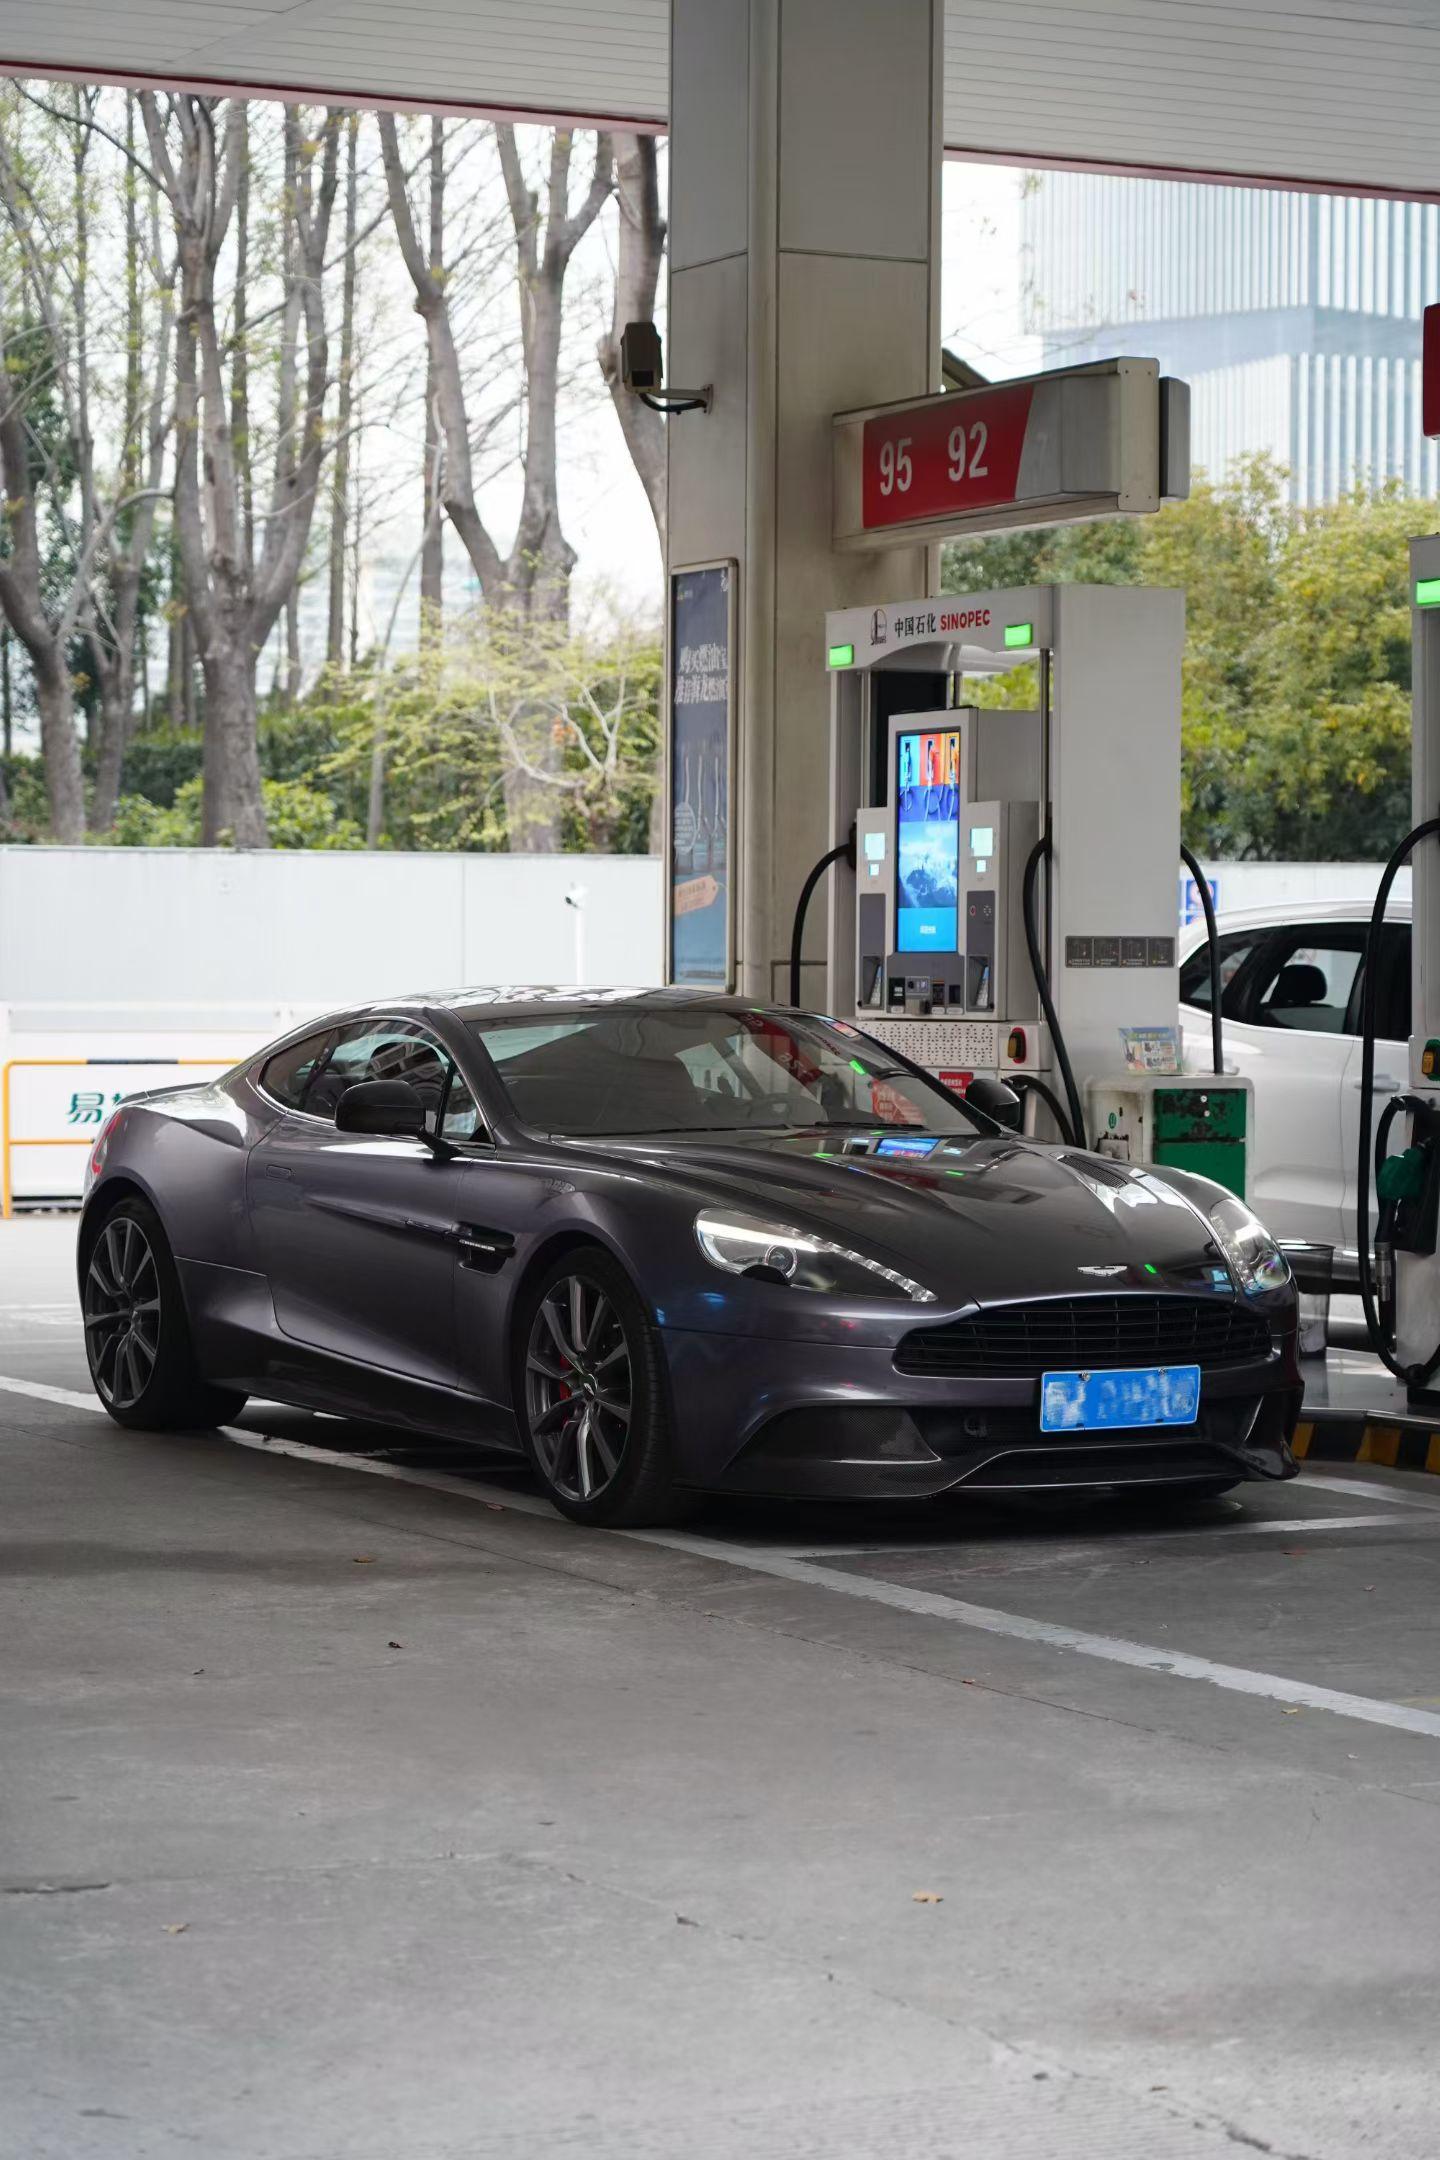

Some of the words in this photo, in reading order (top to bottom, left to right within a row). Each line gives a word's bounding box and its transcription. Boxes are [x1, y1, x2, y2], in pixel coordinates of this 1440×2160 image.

[879, 438, 913, 496] 95
[947, 420, 989, 482] 92
[894, 613, 937, 638] 中国石化
[940, 609, 991, 631] SINOPEC
[67, 1093, 121, 1123] 易
